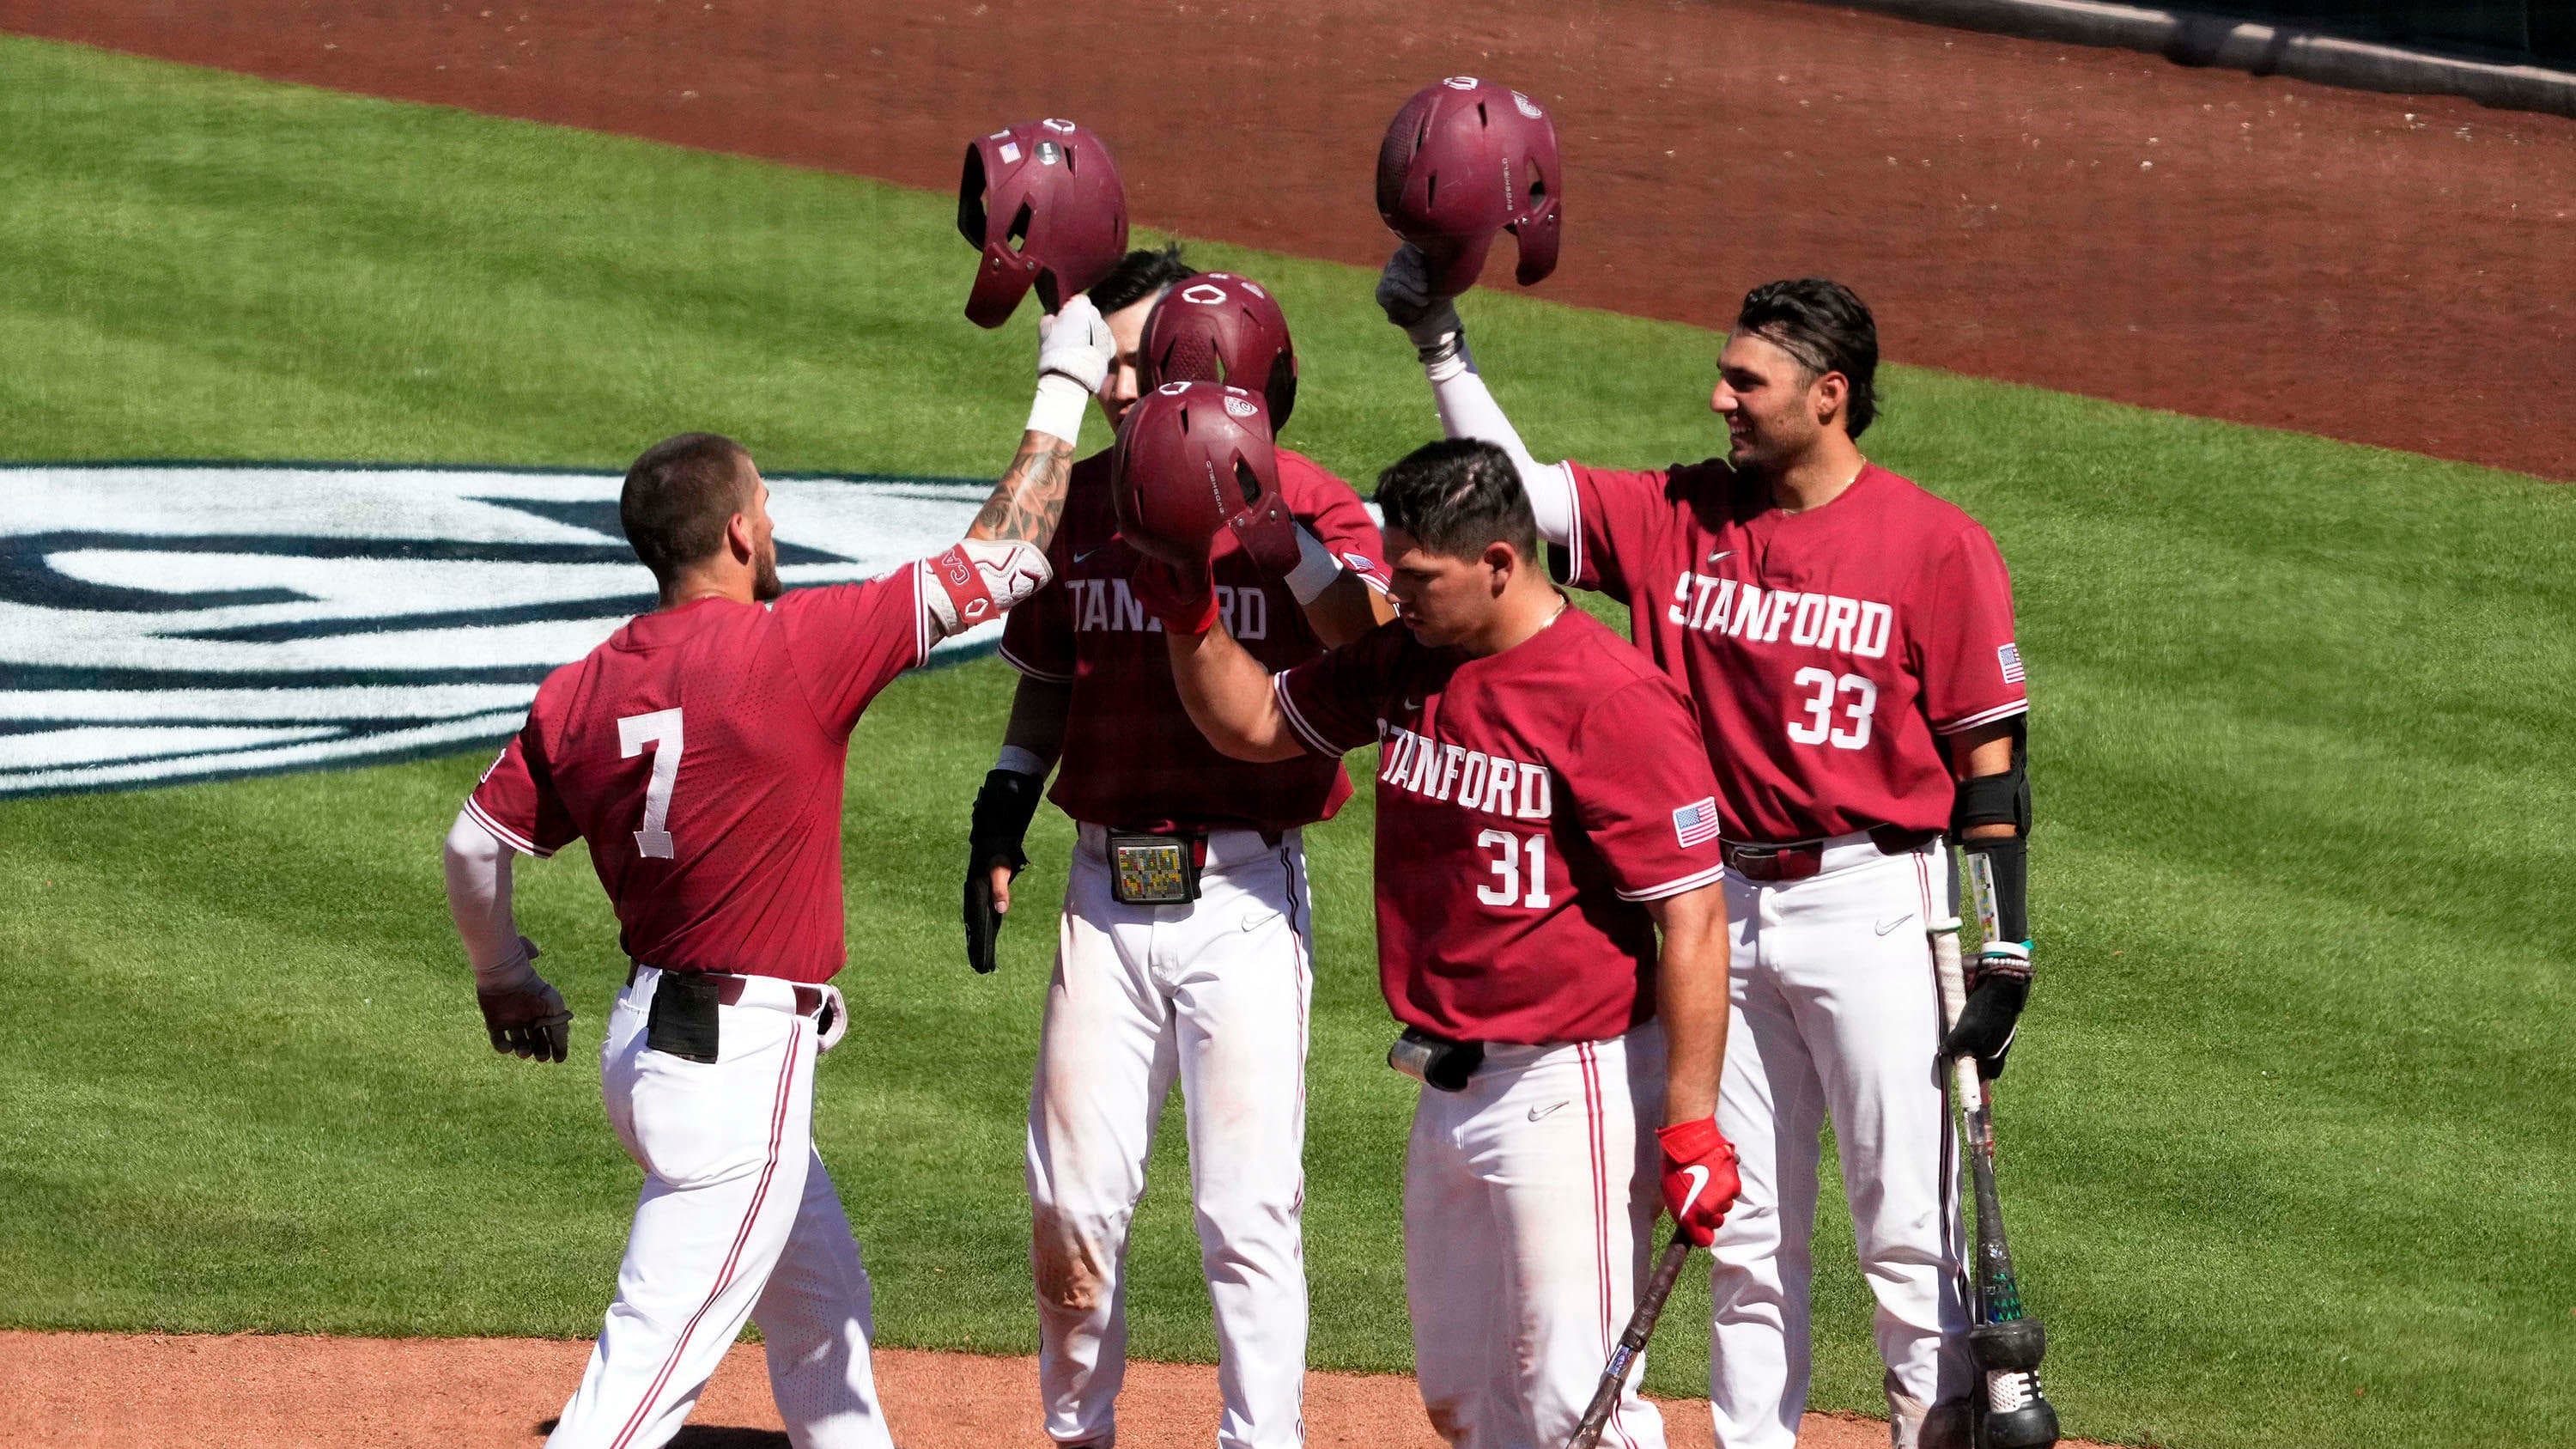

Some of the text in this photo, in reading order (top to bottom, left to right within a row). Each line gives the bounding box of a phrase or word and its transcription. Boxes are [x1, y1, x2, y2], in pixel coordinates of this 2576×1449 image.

[1668, 570, 1894, 659] STANFORD
[1787, 667, 1879, 750] 33
[617, 707, 684, 860] 7
[1476, 828, 1552, 909] 31
